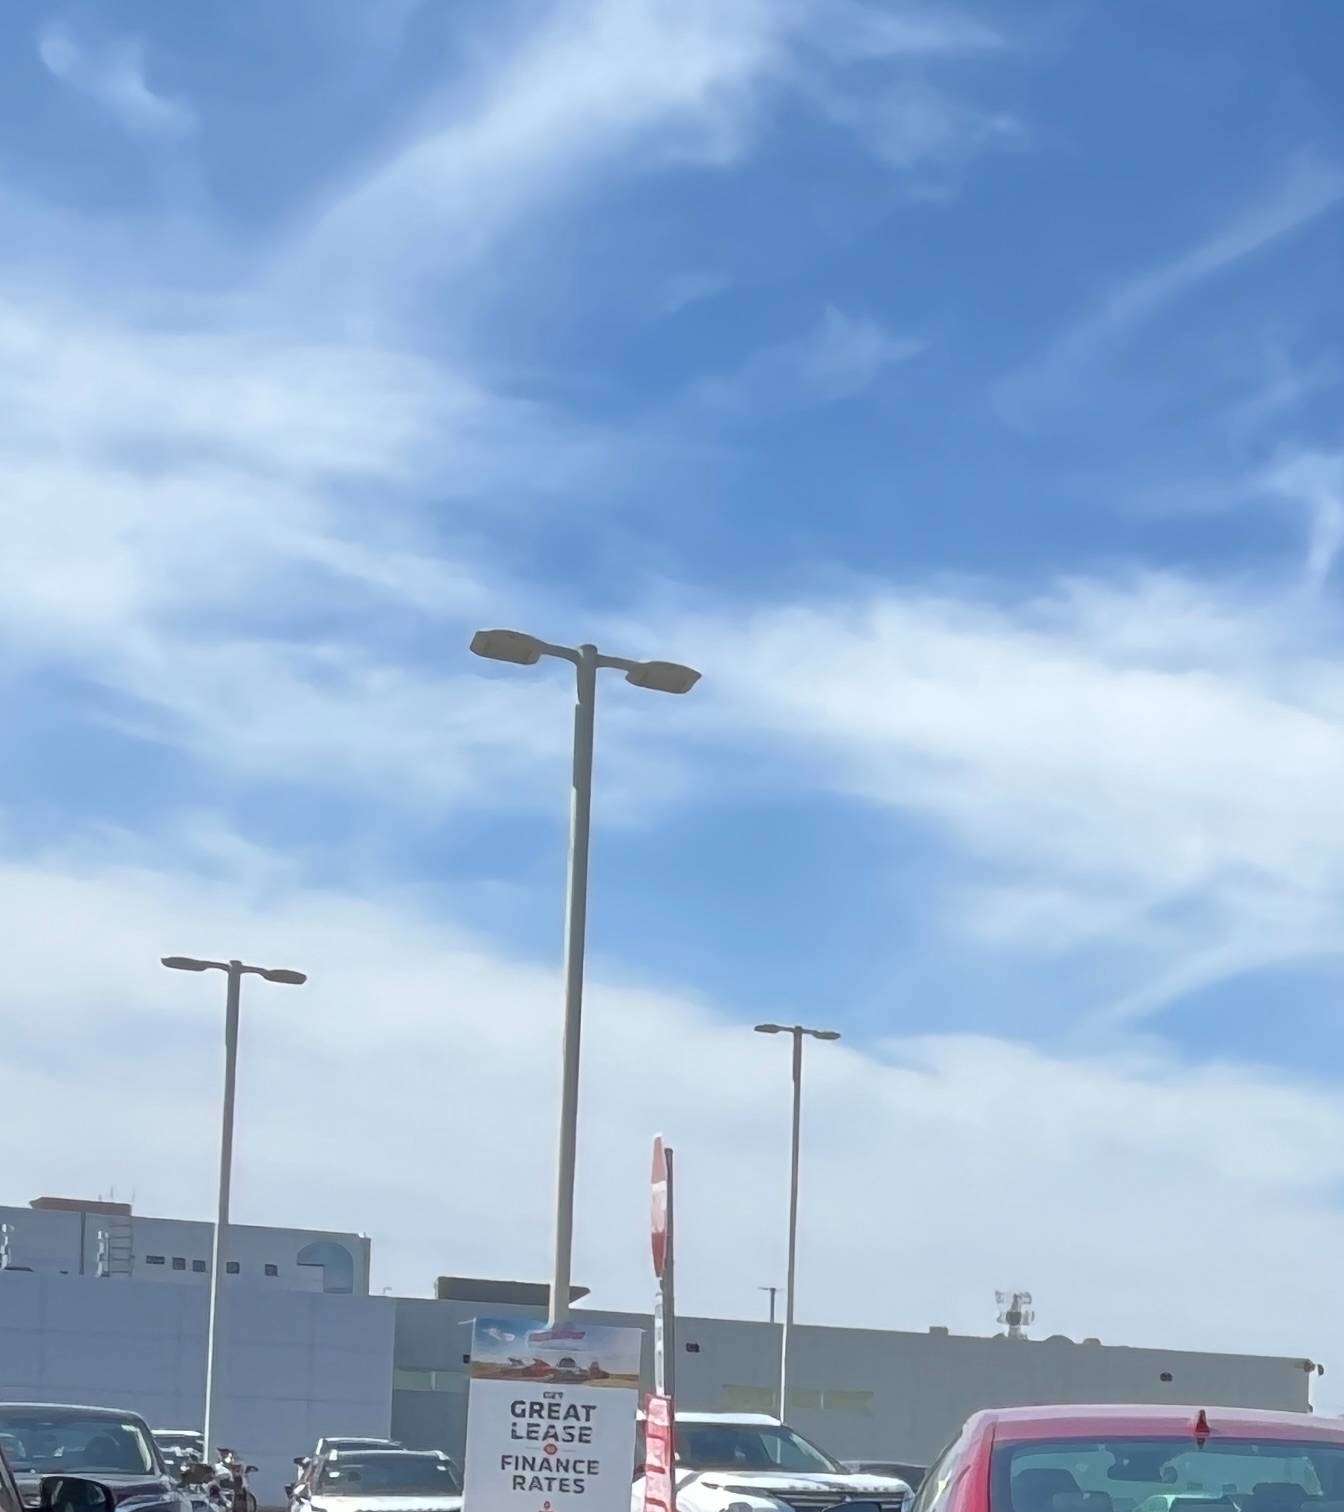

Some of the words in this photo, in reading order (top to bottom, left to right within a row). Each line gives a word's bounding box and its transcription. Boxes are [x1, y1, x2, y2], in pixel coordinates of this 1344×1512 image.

[510, 1400, 597, 1422] GREAT
[511, 1422, 592, 1444] LEASE
[500, 1455, 600, 1475] FINANCE
[512, 1475, 585, 1494] RATES
